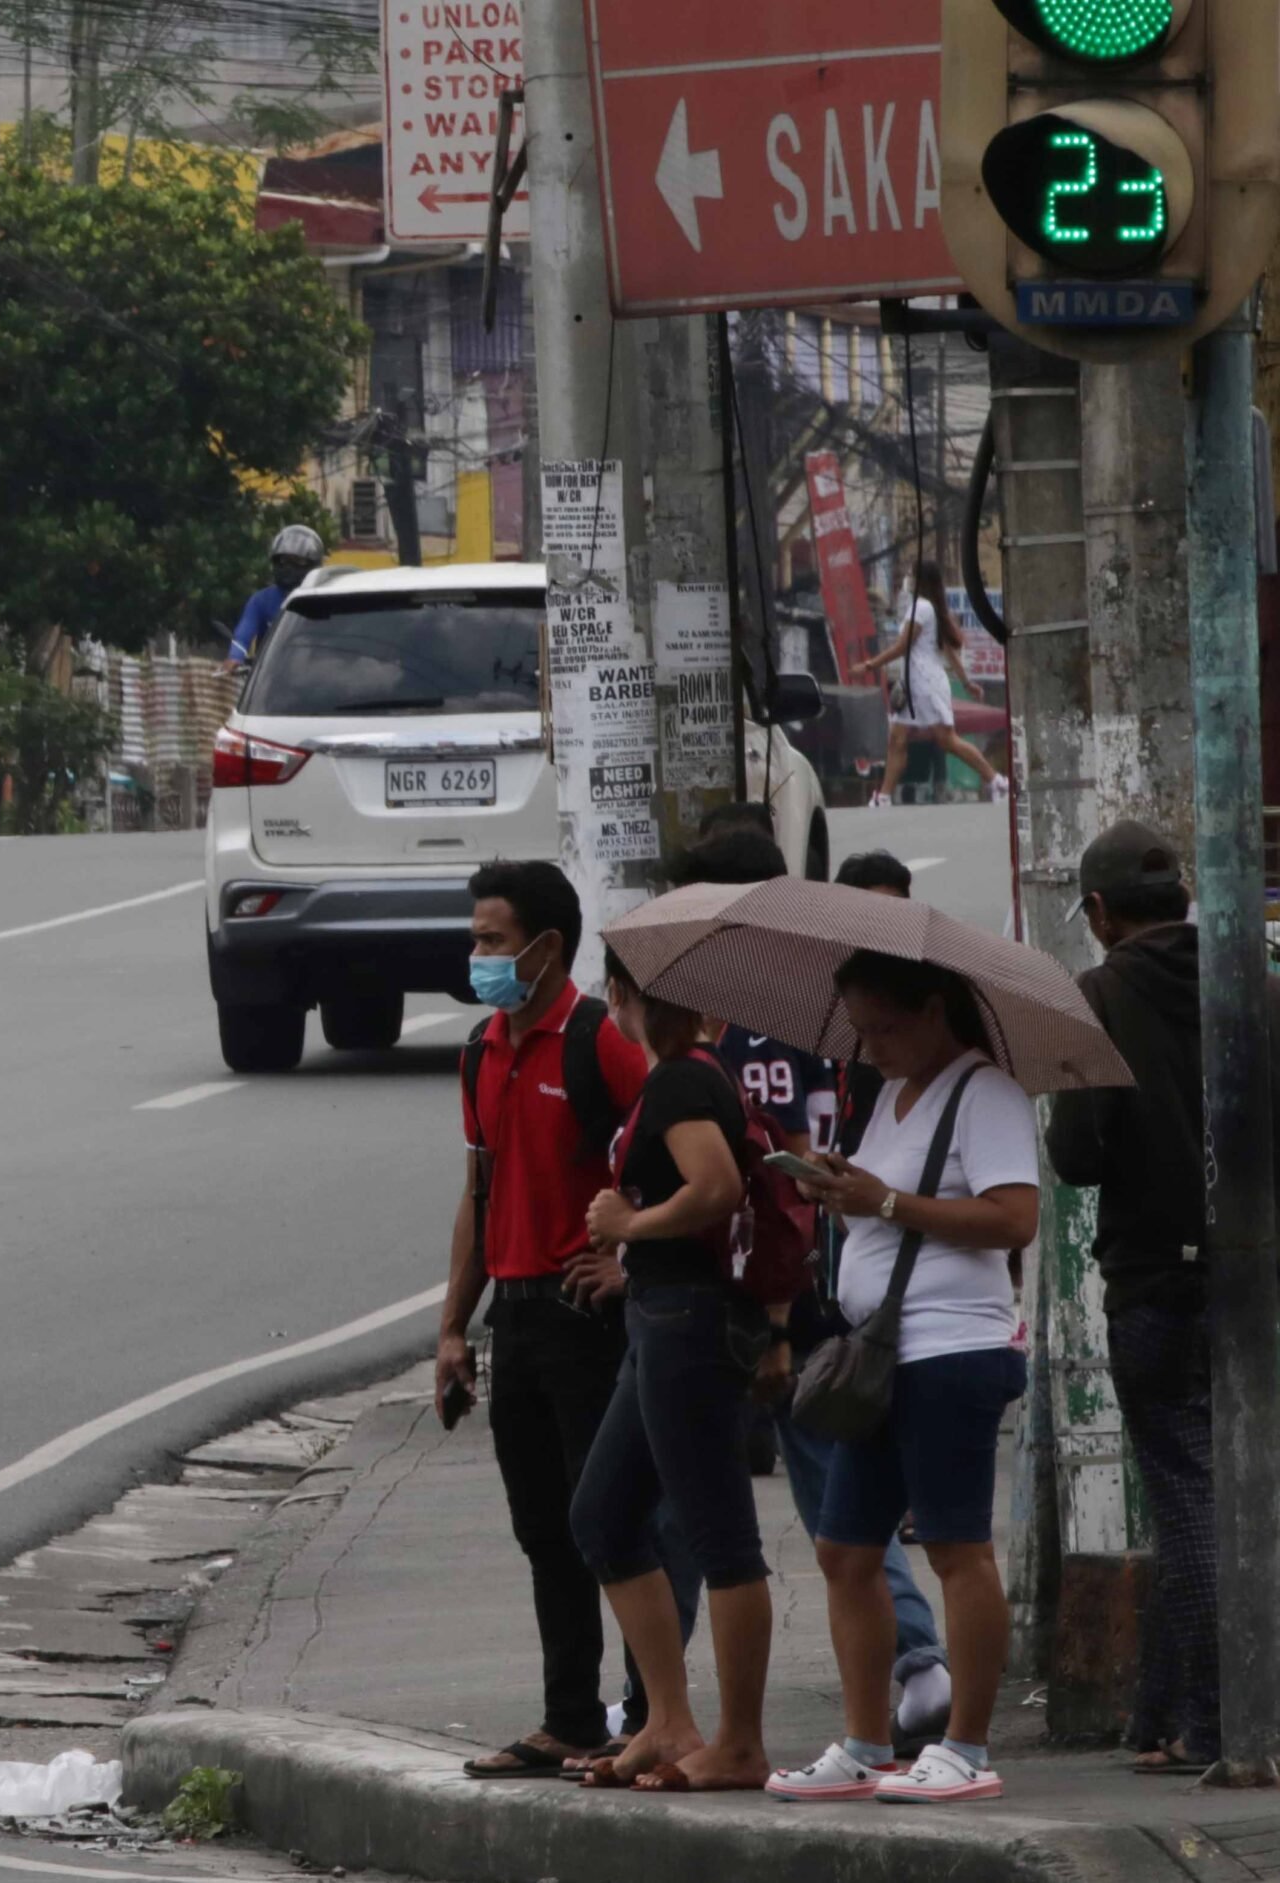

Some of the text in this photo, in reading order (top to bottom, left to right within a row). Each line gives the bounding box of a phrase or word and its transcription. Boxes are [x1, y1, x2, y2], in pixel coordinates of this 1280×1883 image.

[423, 38, 523, 65] PARK
[765, 99, 941, 242] SAKA
[1031, 290, 1181, 317] MMDA
[679, 671, 713, 705] ROOM
[390, 769, 491, 792] NGR 6269
[603, 766, 643, 783] NEED
[742, 1060, 795, 1105] 99
